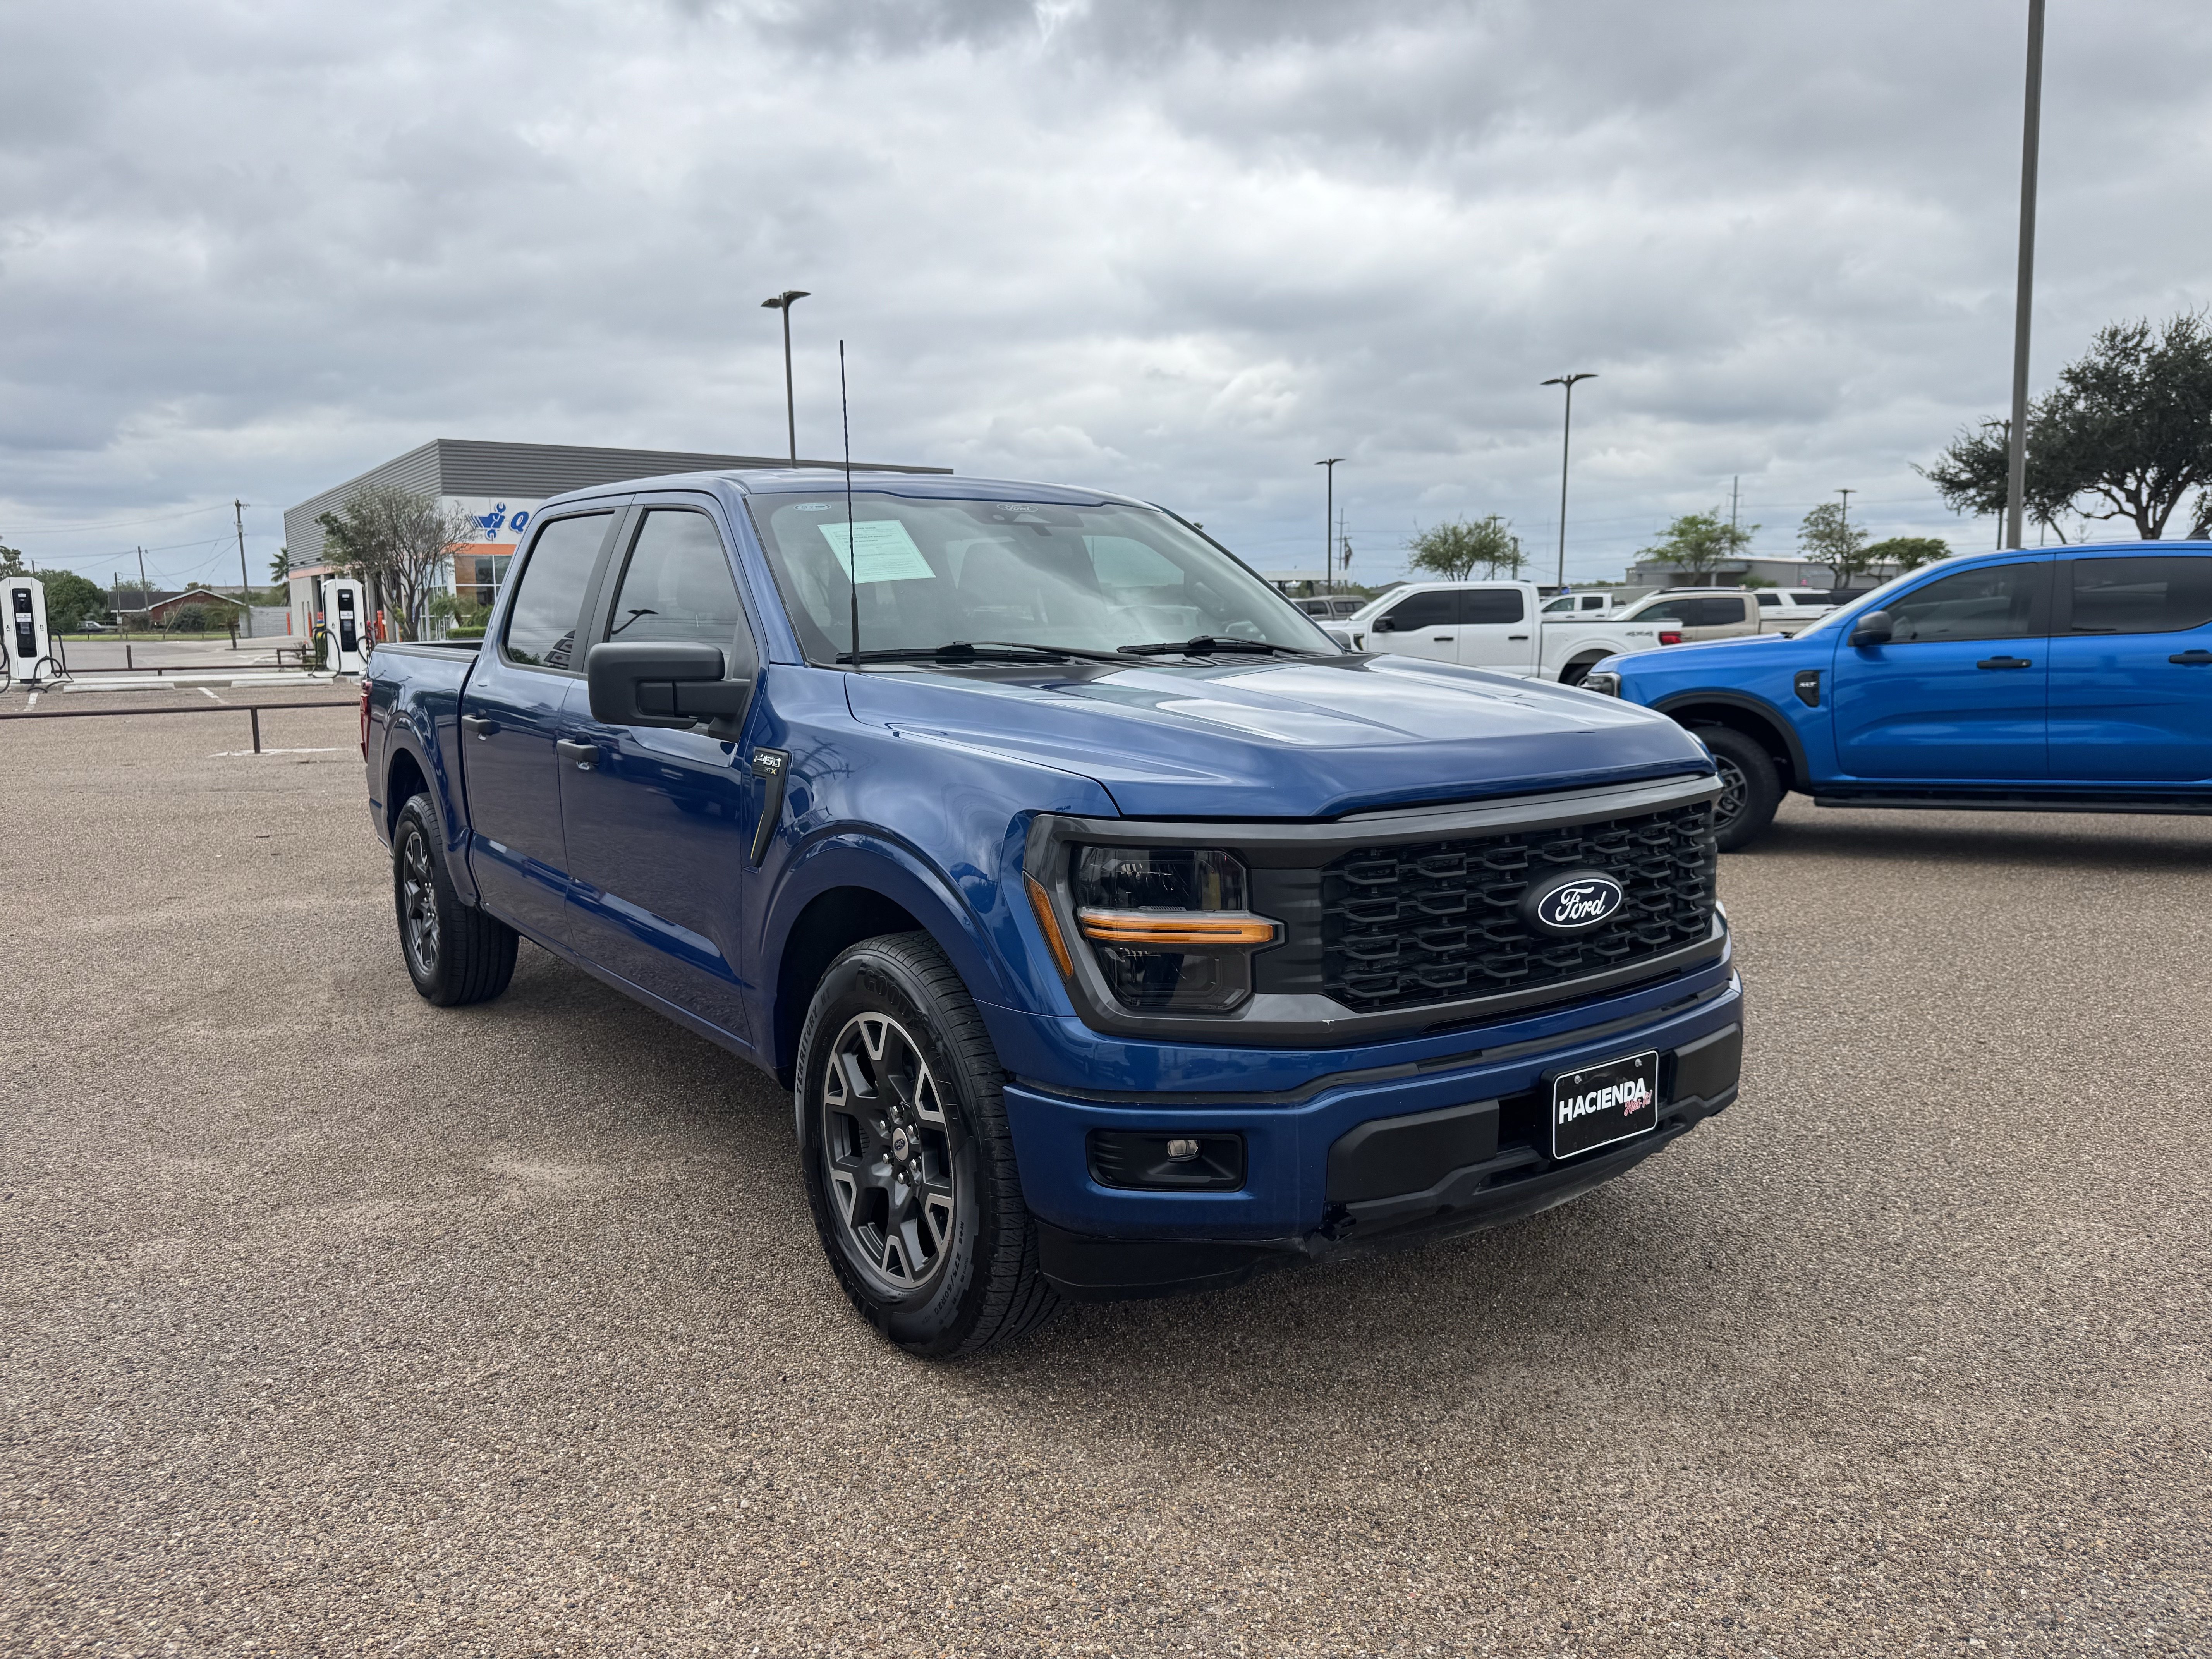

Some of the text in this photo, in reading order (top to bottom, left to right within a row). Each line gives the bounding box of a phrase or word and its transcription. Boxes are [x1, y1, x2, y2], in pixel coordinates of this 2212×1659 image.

[510, 511, 529, 534] Q
[1555, 886, 1607, 922] Ford
[796, 1005, 818, 1095] TERRITORY
[1559, 1077, 1646, 1124] HACIENDA
[934, 1251, 962, 1315] 275/60R20
